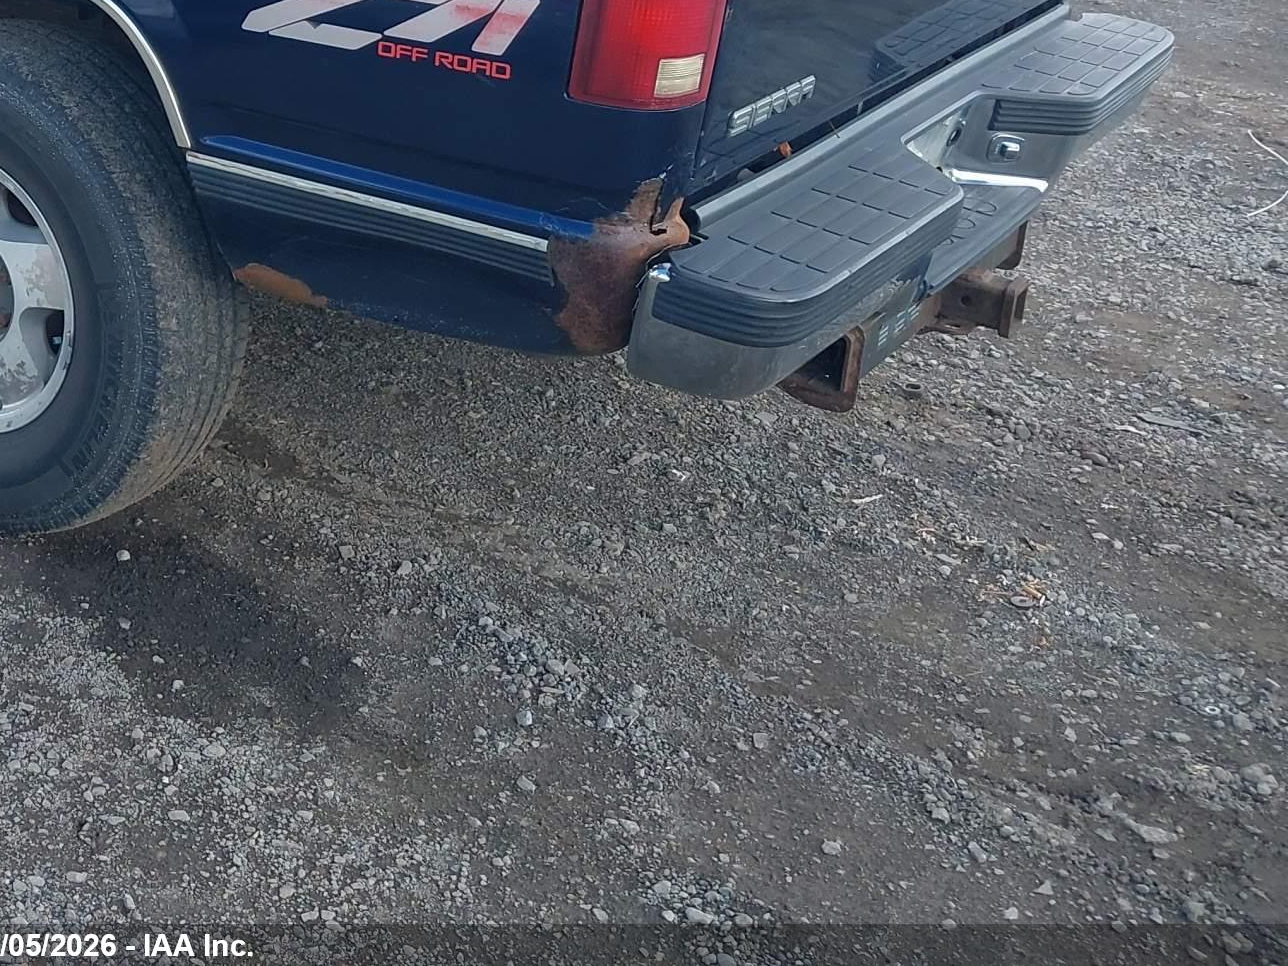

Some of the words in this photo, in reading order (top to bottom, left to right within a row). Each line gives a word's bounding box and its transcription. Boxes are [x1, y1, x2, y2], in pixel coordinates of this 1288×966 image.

[377, 41, 429, 62] OFF
[434, 51, 512, 80] ROAD
[727, 74, 816, 138] SIERRA
